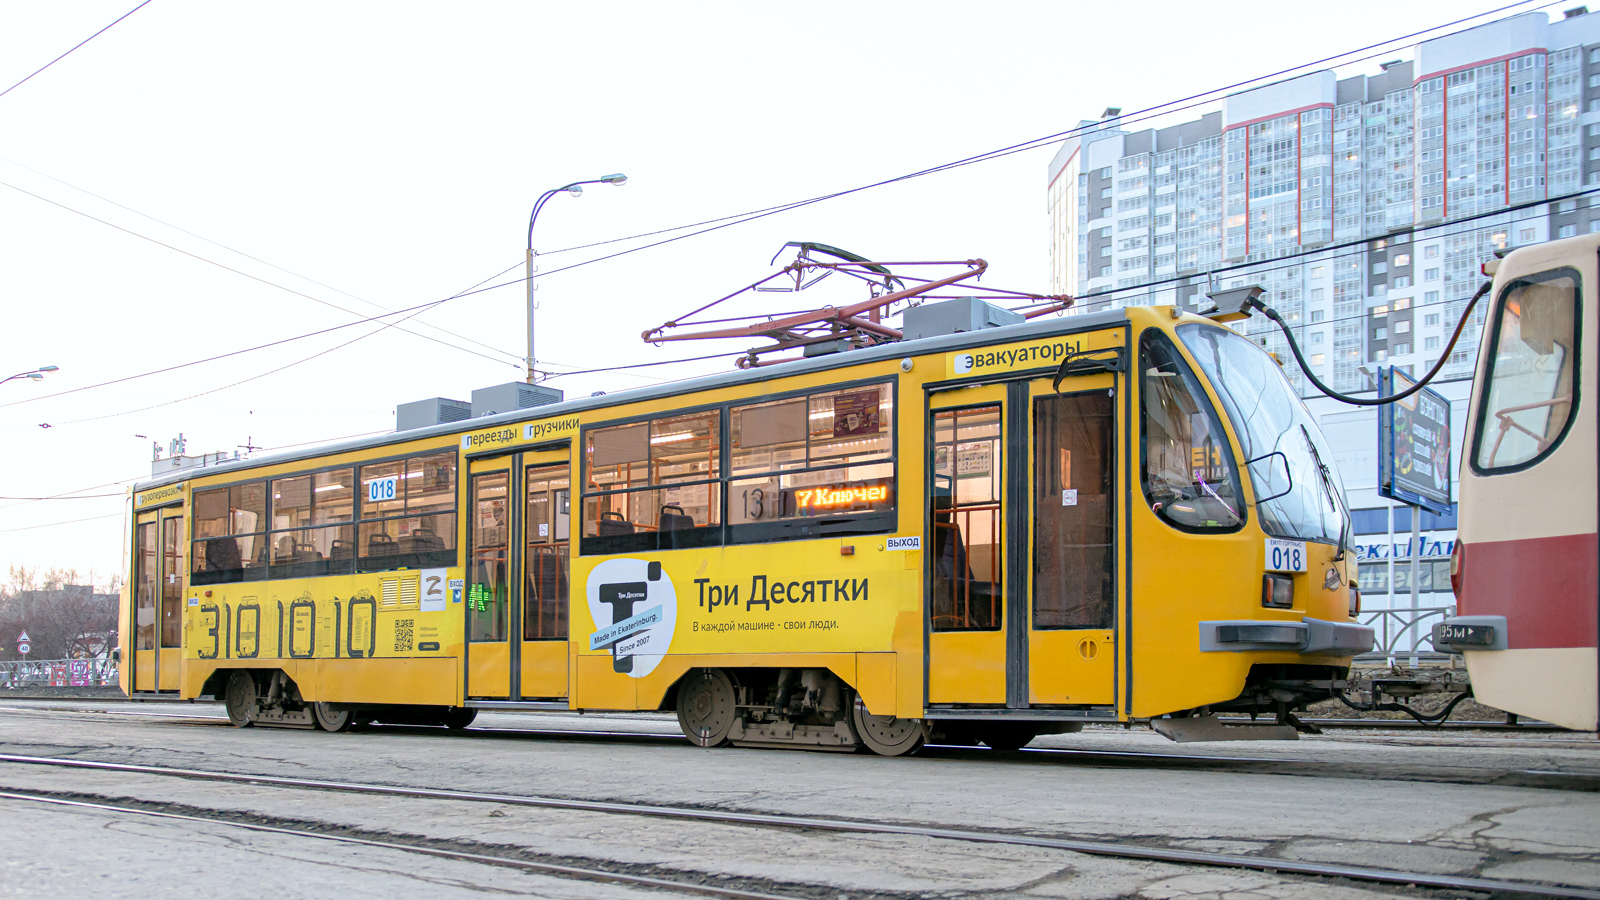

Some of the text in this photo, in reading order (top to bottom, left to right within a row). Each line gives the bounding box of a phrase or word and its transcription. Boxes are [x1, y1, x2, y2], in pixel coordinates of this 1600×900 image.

[965, 338, 1081, 370] эвакуаторы
[466, 427, 518, 447] переезды
[529, 417, 580, 438] грузчики
[371, 480, 394, 500] 018
[799, 490, 812, 506] 7
[888, 538, 919, 549] ВЫХОД
[1272, 546, 1301, 571] 018
[425, 575, 443, 596] Z
[449, 580, 463, 588] ВХОД
[694, 575, 869, 613] Три Десятки
[626, 591, 645, 599] Десятки
[594, 614, 658, 645] Made in Ekaterinburg.
[693, 622, 699, 632] В
[701, 620, 736, 634] каждой
[738, 621, 775, 631] машине
[783, 620, 806, 630] свои
[809, 619, 839, 632] люди.
[619, 635, 651, 653] Since 2007
